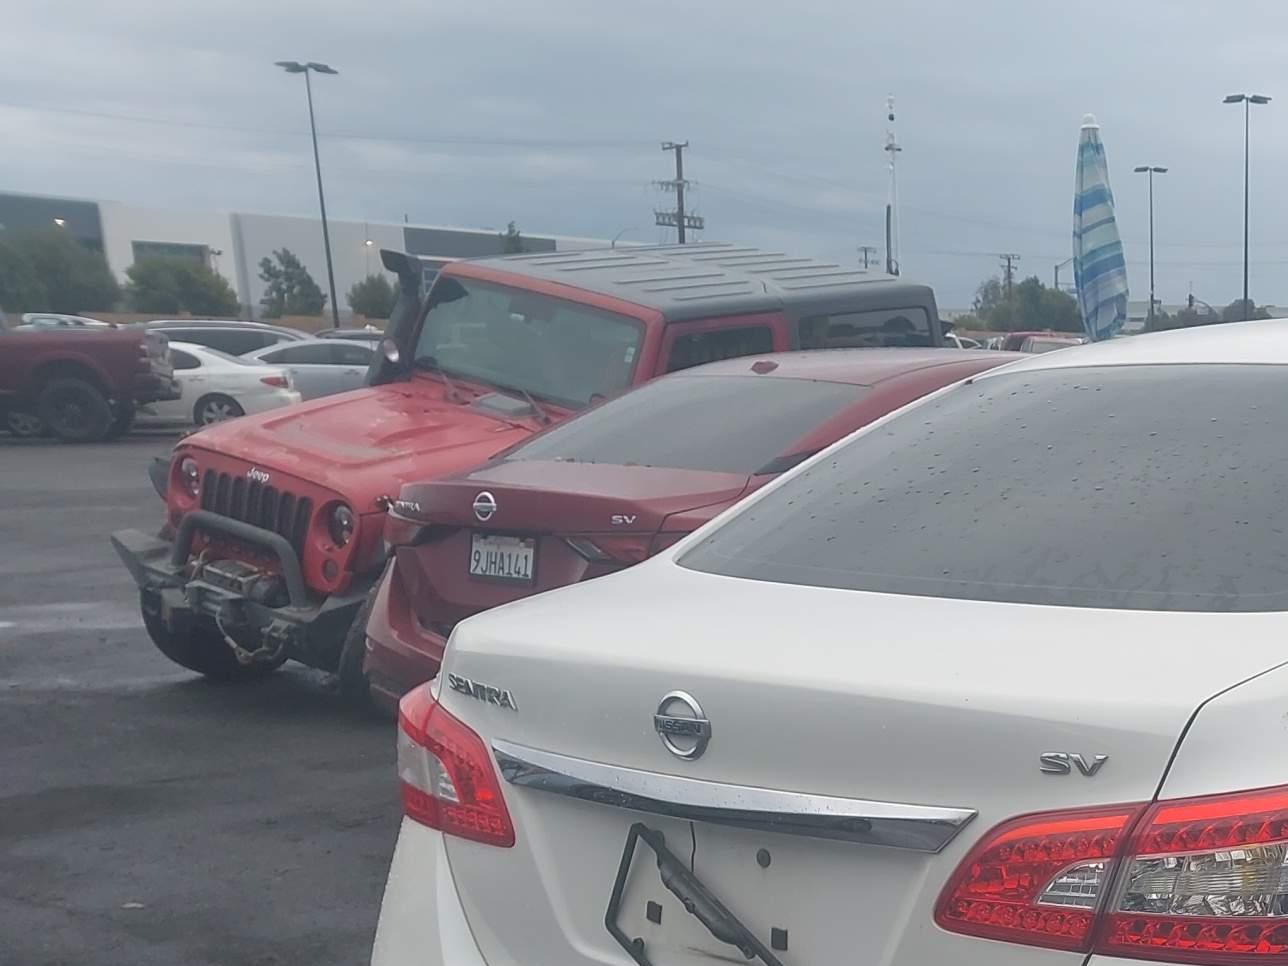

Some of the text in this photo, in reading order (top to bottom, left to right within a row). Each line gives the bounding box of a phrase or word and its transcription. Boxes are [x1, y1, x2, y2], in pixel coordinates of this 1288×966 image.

[247, 466, 270, 484] Jeep
[610, 514, 637, 525] SV
[473, 549, 529, 578] 9JHA141
[448, 672, 519, 711] SENTRA
[1040, 752, 1109, 776] SV
